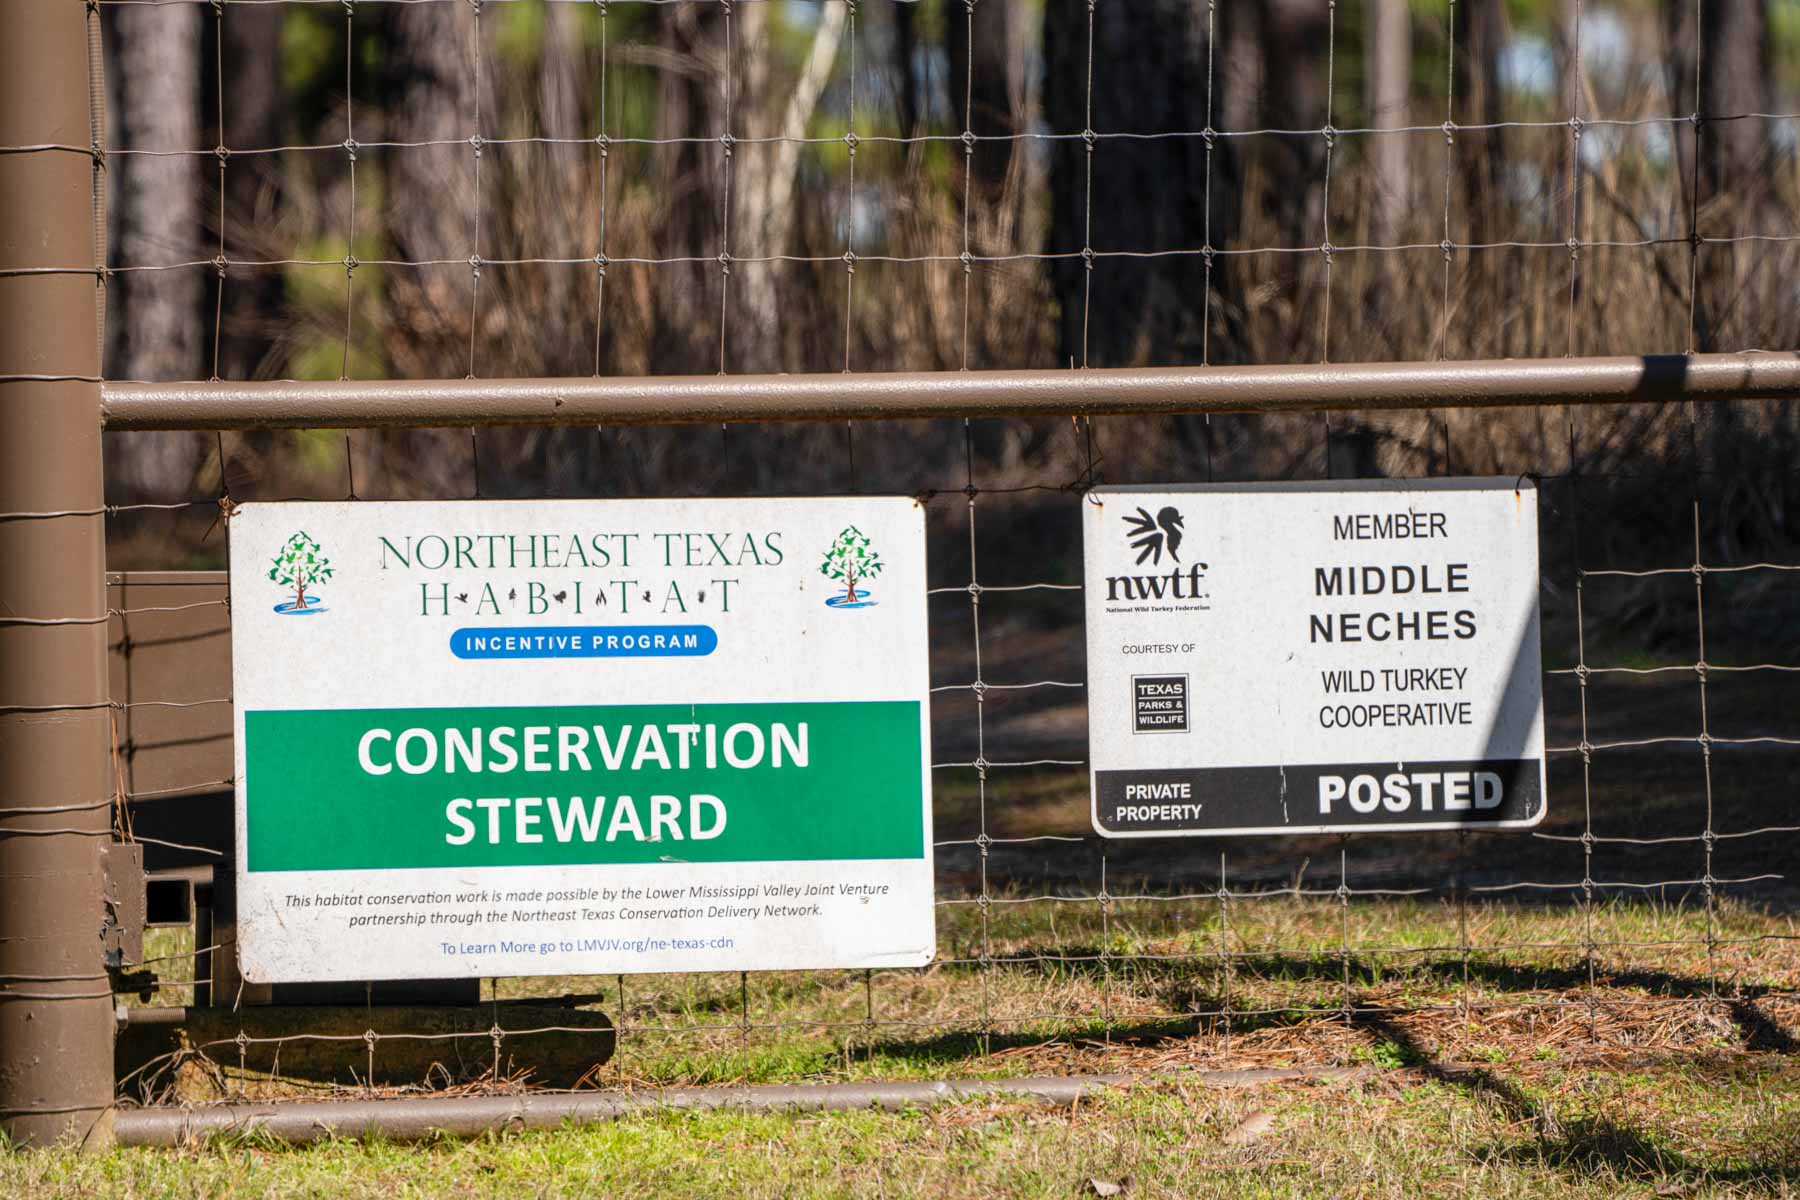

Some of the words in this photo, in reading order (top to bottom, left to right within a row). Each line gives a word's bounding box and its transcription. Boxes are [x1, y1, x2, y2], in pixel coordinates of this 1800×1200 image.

[1333, 513, 1448, 540] MEMBER
[378, 534, 640, 570] NORTHEAST
[653, 531, 784, 567] TEXAS
[1314, 564, 1470, 596] MIDDLE
[1309, 610, 1477, 643] NECHES
[465, 635, 583, 652] INCENTIVE
[593, 633, 699, 651] PROGRAM
[1122, 644, 1179, 654] COURTESY
[1181, 644, 1196, 653] OF
[1138, 684, 1183, 695] TEXAS
[1321, 670, 1375, 693] WILD
[1380, 667, 1467, 692] TURKEY
[1138, 701, 1172, 709] PARKS
[1175, 701, 1183, 709] &
[1319, 702, 1473, 728] COOPERATIVE
[1139, 715, 1184, 724] WILDLIFE
[357, 722, 810, 776] CONSERVATION
[1126, 784, 1191, 800] PRIVATE
[1319, 772, 1504, 814] POSTED
[444, 794, 728, 846] STEWARD
[1116, 804, 1202, 822] PROPERTY
[285, 894, 311, 907] This
[315, 892, 363, 906] habitat
[367, 891, 451, 905] conservation
[455, 889, 488, 903] work
[492, 889, 502, 902] is
[506, 888, 543, 902] made
[546, 886, 599, 903] possible
[602, 886, 618, 901] by
[621, 885, 642, 899] the
[645, 885, 685, 899] Lower
[689, 883, 760, 899] Mississippi
[764, 883, 802, 900] Valley
[804, 882, 835, 897] Joint
[839, 882, 889, 896] Venture
[349, 910, 426, 928] partnership
[430, 909, 483, 927] through
[487, 909, 508, 923] the
[511, 908, 577, 922] Northeast
[582, 906, 615, 920] Texas
[619, 904, 703, 920] Conservation
[708, 903, 760, 920] Delivery
[764, 902, 823, 918] Network.
[441, 941, 456, 955] To
[460, 940, 496, 954] Learn
[500, 940, 536, 953] More
[540, 941, 556, 957] go
[560, 940, 573, 953] to
[576, 936, 734, 952] LMVJV.org/ne-texas-cdn
